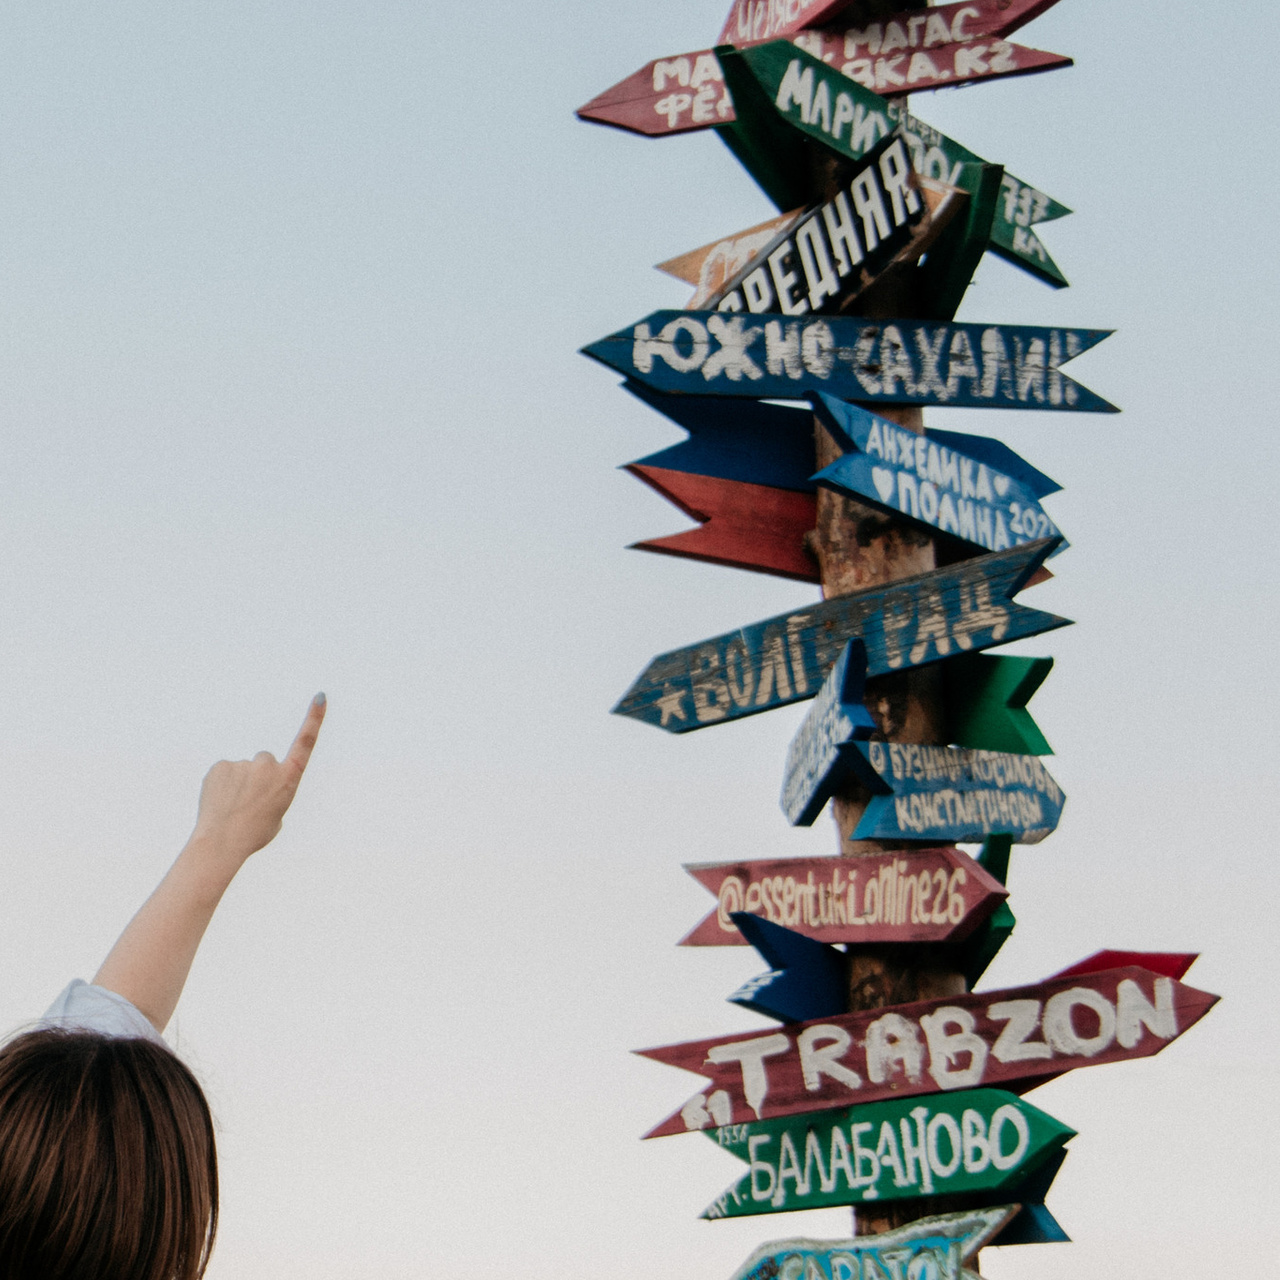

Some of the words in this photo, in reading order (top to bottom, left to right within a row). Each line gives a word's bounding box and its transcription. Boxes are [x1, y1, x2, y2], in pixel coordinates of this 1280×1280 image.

[865, 419, 993, 504] АНЖЕЛИКА
[705, 977, 1180, 1121] TRABZON
[748, 1103, 1030, 1207] БАЛАБАНОВО
